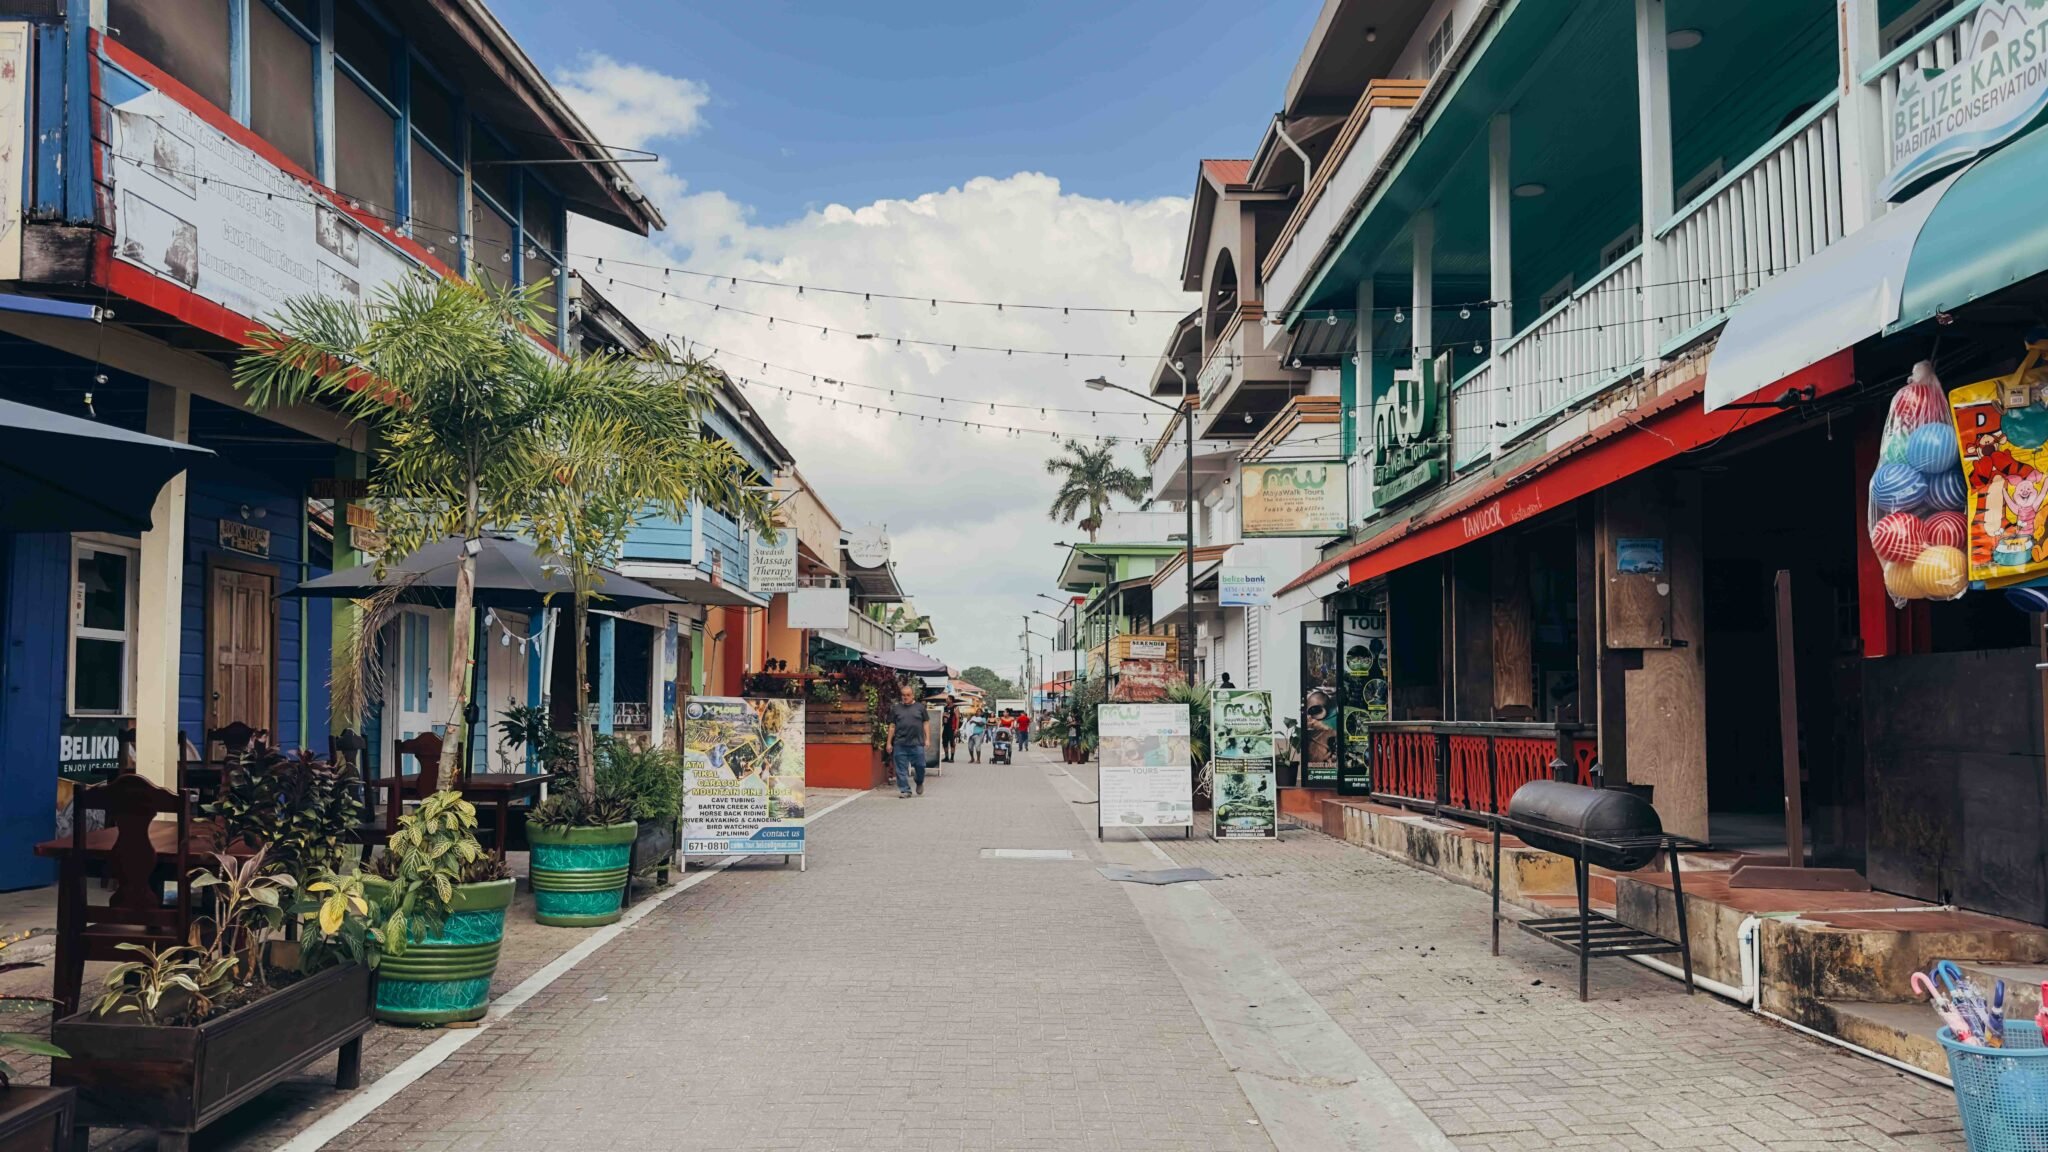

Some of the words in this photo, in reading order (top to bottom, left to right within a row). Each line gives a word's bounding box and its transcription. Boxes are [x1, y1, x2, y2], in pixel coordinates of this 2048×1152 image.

[1895, 74, 1962, 141] BELIZE
[1970, 22, 2048, 96] KARST
[1895, 119, 1944, 160] HABITAT
[1946, 59, 2048, 133] CONSERVATION
[1262, 489, 1301, 498] MayaWalk
[753, 548, 785, 556] Swedish
[752, 556, 793, 567] Massage
[753, 565, 792, 578] Therapy
[1222, 574, 1245, 583] belize
[1244, 574, 1266, 583] bank
[1313, 626, 1335, 635] ATM
[63, 763, 87, 773] ENJOY
[685, 761, 704, 769] ATM
[693, 770, 719, 778] TIKAL
[697, 779, 740, 788] CARACOL
[692, 788, 739, 796] MOUNTAIN
[742, 788, 762, 796] PINE
[688, 842, 729, 851] 671-0810
